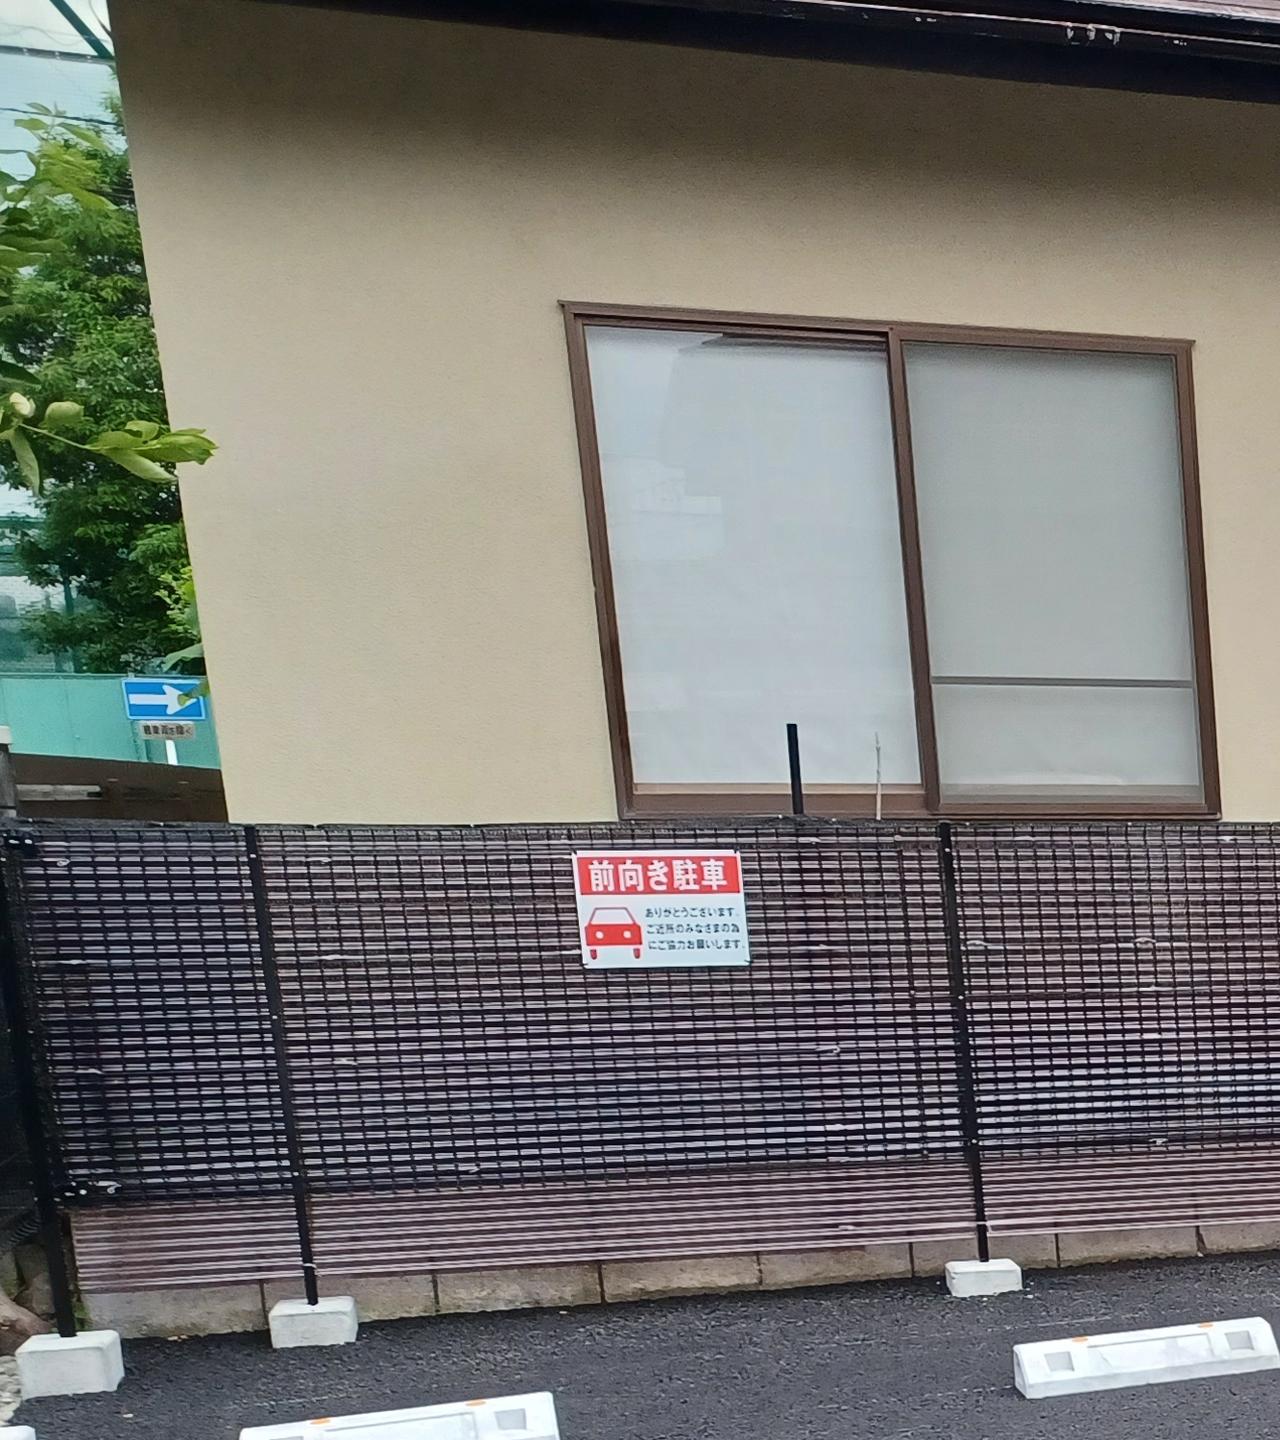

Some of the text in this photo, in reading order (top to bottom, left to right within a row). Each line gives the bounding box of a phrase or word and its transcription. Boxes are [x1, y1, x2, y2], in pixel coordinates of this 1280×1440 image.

[588, 859, 728, 891] 前向き駐車
